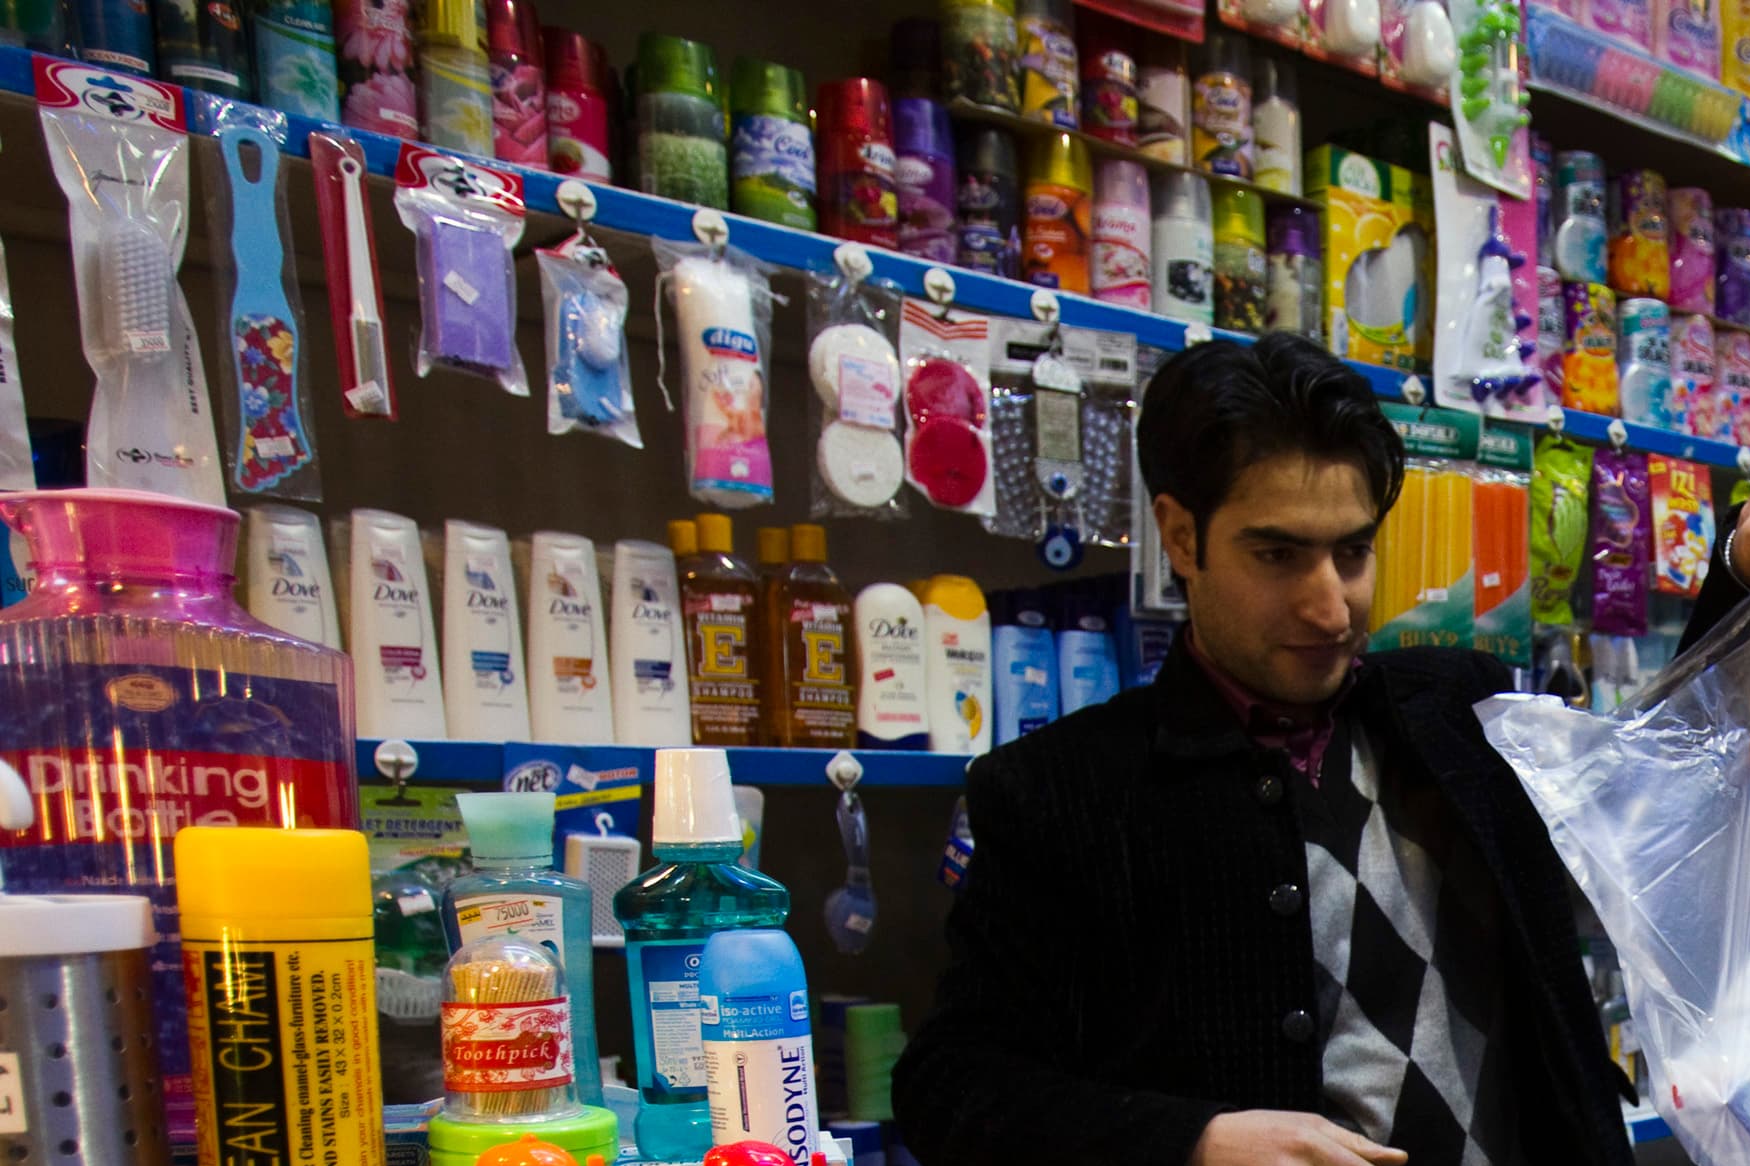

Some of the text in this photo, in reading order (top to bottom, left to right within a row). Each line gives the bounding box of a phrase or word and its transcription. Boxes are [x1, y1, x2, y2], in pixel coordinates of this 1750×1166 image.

[271, 577, 320, 598] Dove
[373, 583, 419, 604] Dove
[466, 590, 509, 609] Dove
[549, 599, 592, 617] Dove
[632, 603, 672, 621] Dove
[869, 617, 919, 640] Dove
[697, 623, 748, 678] E
[802, 631, 844, 686] E
[27, 755, 269, 809] Drinking
[387, 818, 463, 833] DETERGENT
[285, 951, 300, 972] etc.
[212, 960, 274, 1073] CHAM
[312, 971, 331, 1045] REMOVED.
[333, 1029, 346, 1045] 32
[453, 1041, 555, 1065] Toothpick
[316, 1049, 335, 1095] EASILY
[335, 1060, 348, 1077] 43
[338, 1092, 351, 1119] Size
[299, 1107, 316, 1160] Cleaning
[319, 1098, 338, 1147] STAINS
